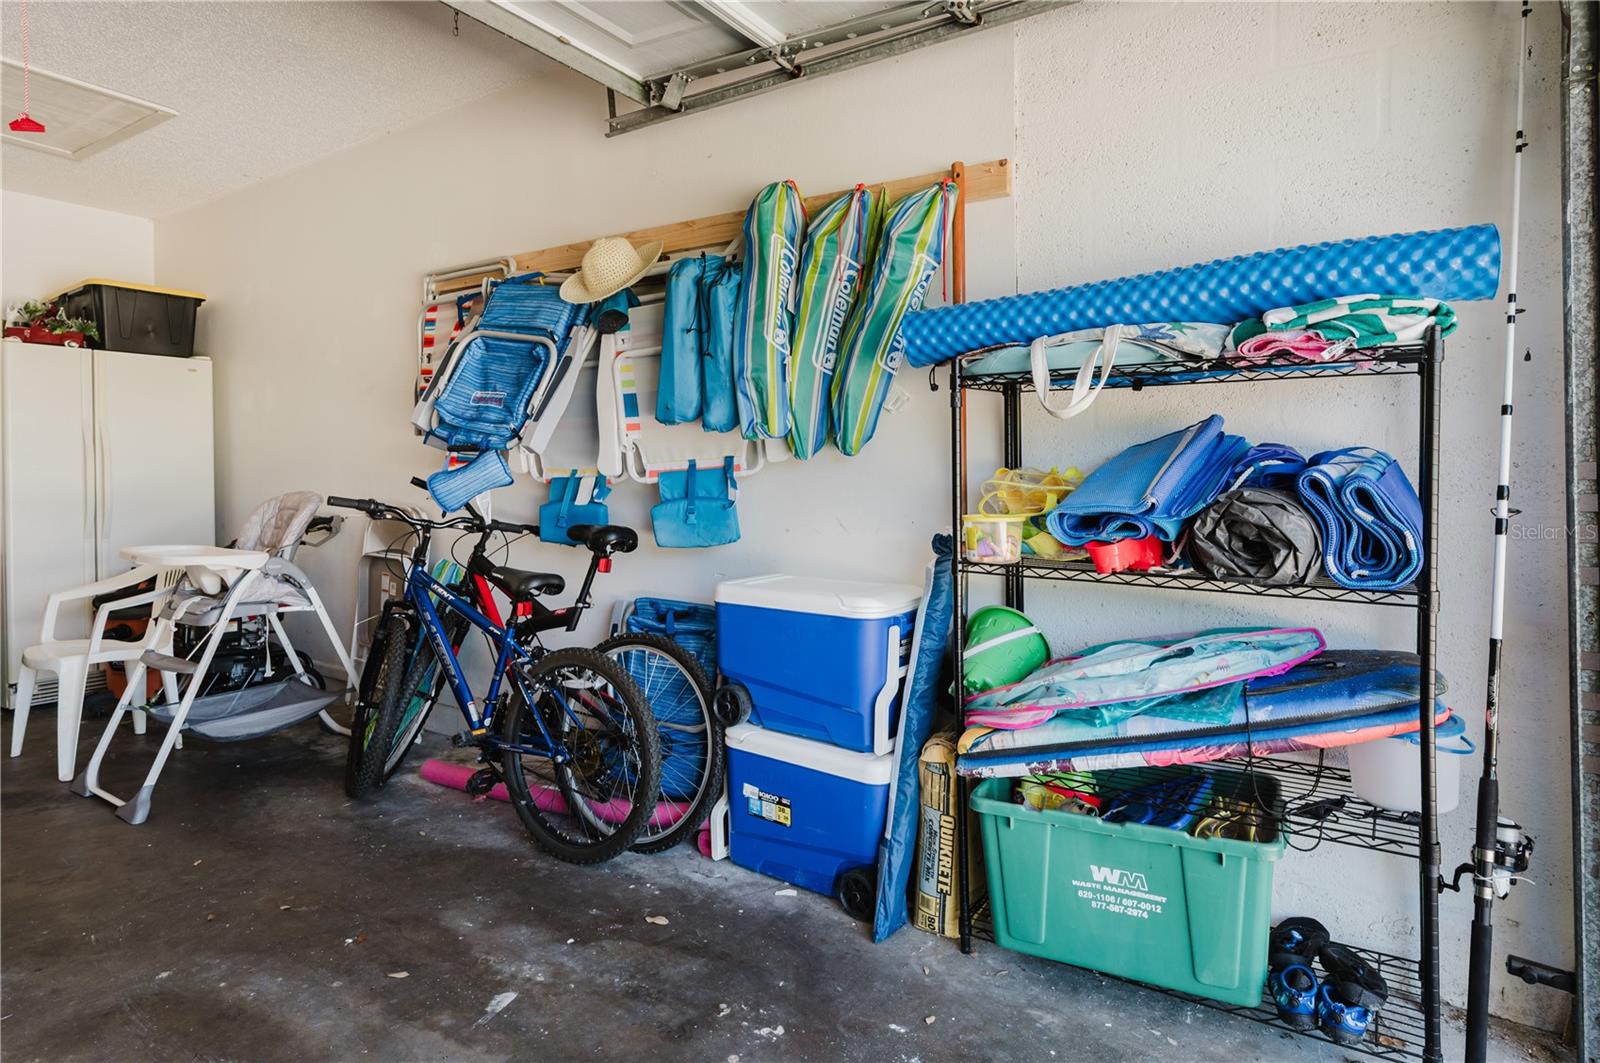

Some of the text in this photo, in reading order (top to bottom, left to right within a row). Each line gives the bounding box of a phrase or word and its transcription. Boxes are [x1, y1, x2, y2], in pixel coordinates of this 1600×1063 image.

[825, 269, 859, 349] Coleman
[430, 582, 455, 600] KENT
[937, 815, 955, 895] QUIKRETE
[1090, 864, 1148, 891] WM
[1072, 880, 1167, 903] WASTE MANAGEMENT
[927, 915, 936, 930] 80
